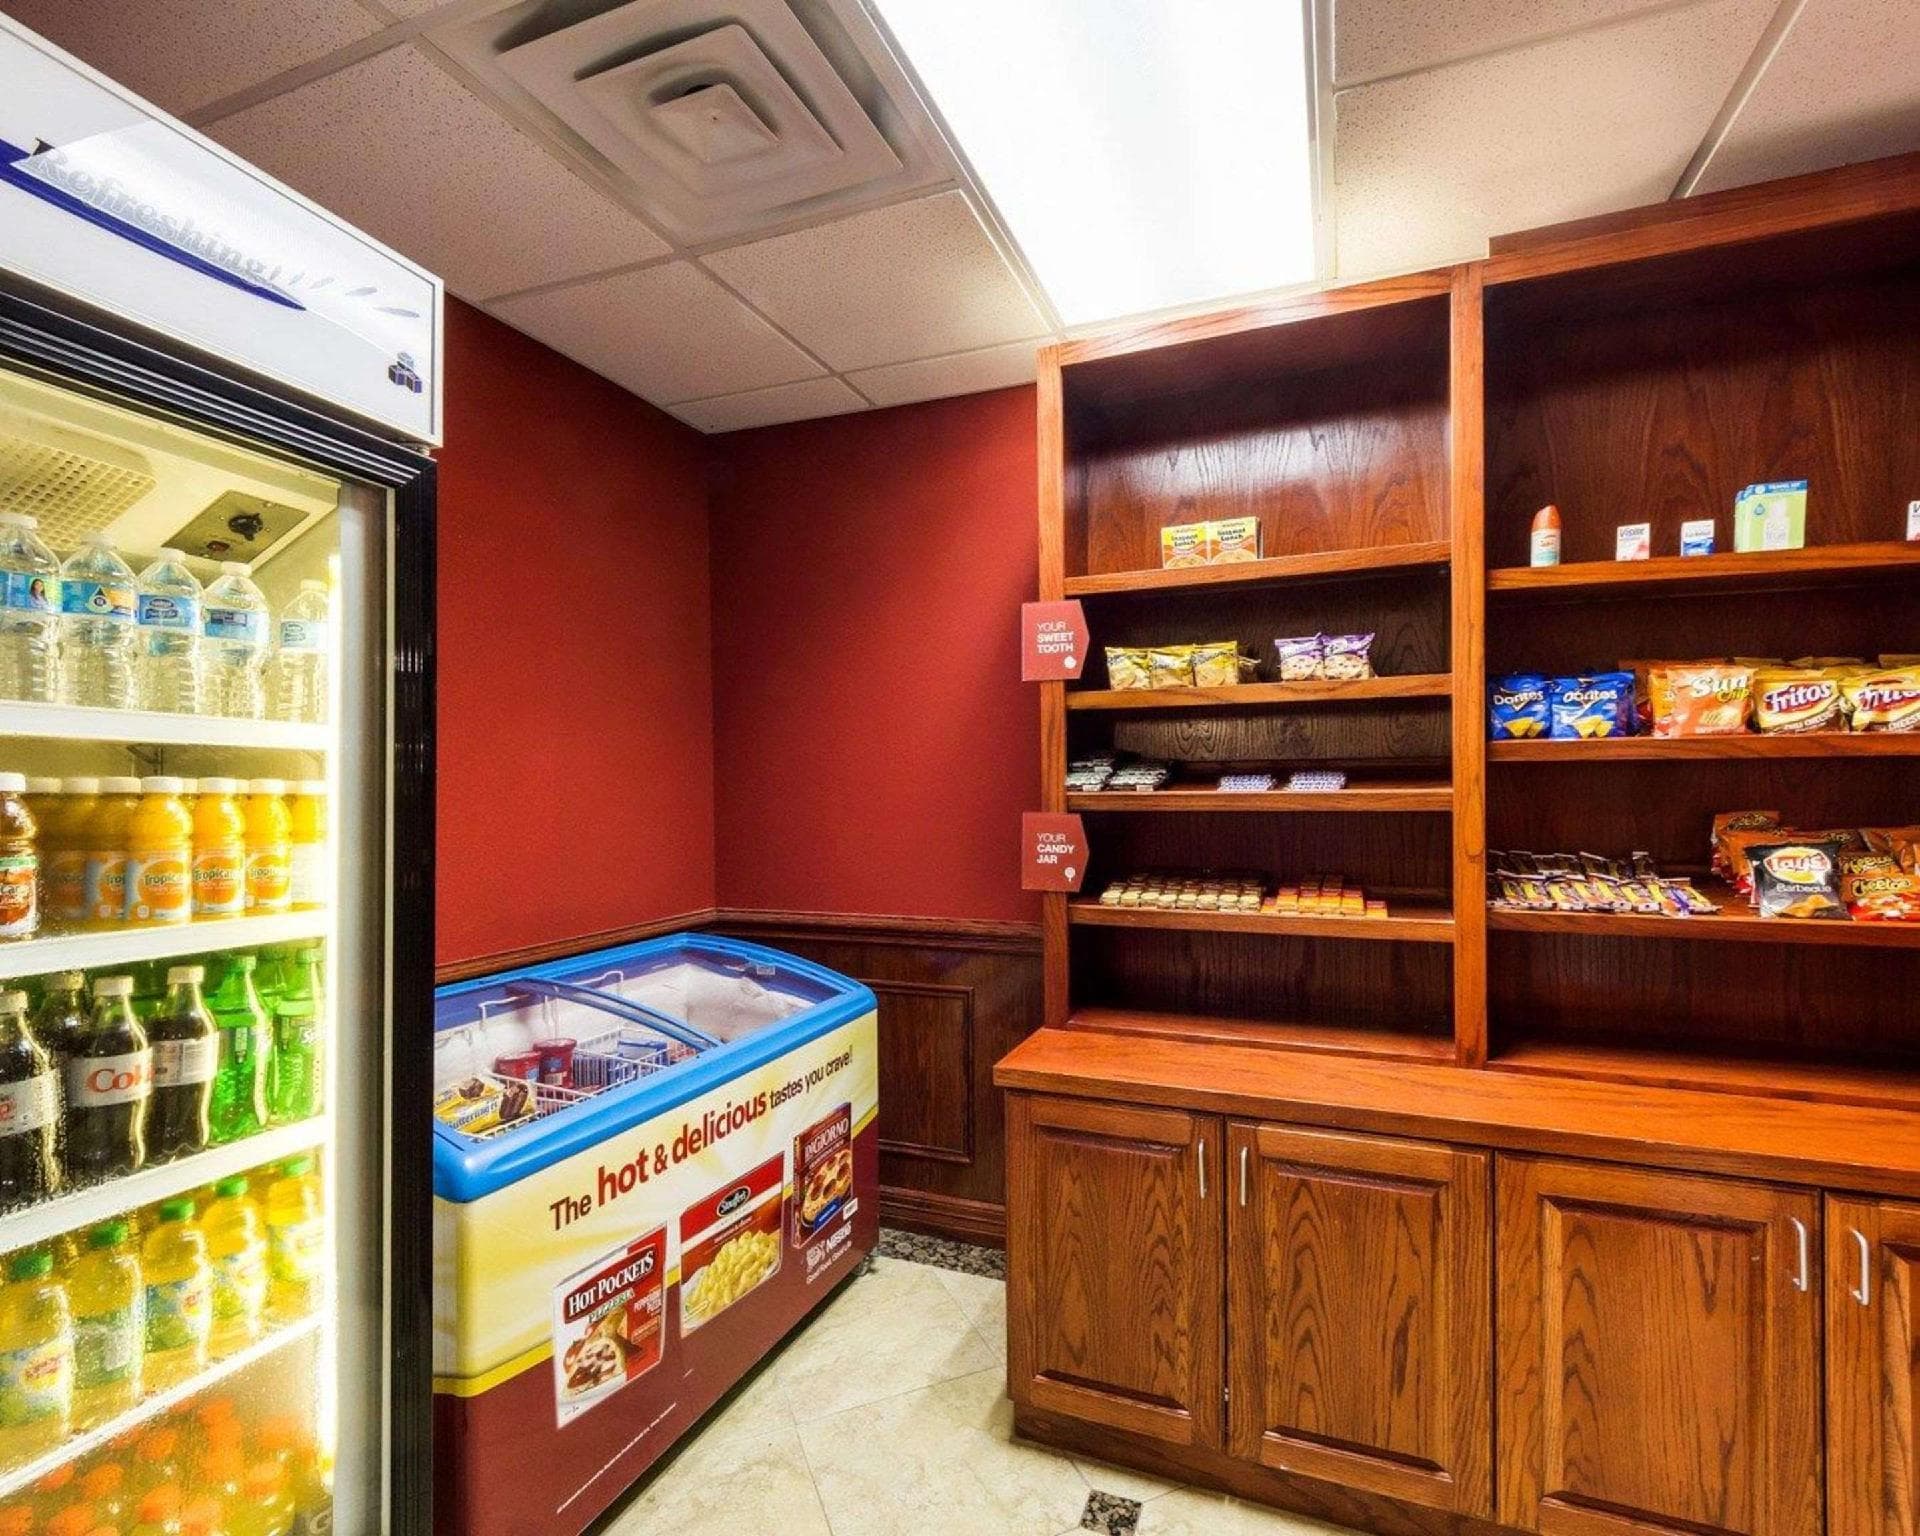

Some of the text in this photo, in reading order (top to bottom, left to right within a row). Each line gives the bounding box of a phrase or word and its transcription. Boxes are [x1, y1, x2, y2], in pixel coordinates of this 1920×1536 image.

[1036, 620, 1066, 632] YOUR
[1036, 631, 1074, 643] SWEET
[1036, 642, 1074, 654] TOOTH
[1492, 690, 1545, 706] Doritos
[1764, 682, 1833, 713] Fritos
[1036, 832, 1066, 843] YOUR
[1036, 843, 1075, 855] CANDY
[1036, 854, 1058, 864] JAR
[550, 1044, 854, 1231] The hot & delicious tastes you crave!
[568, 1286, 597, 1318] HOT
[597, 1249, 655, 1301] POCKETS
